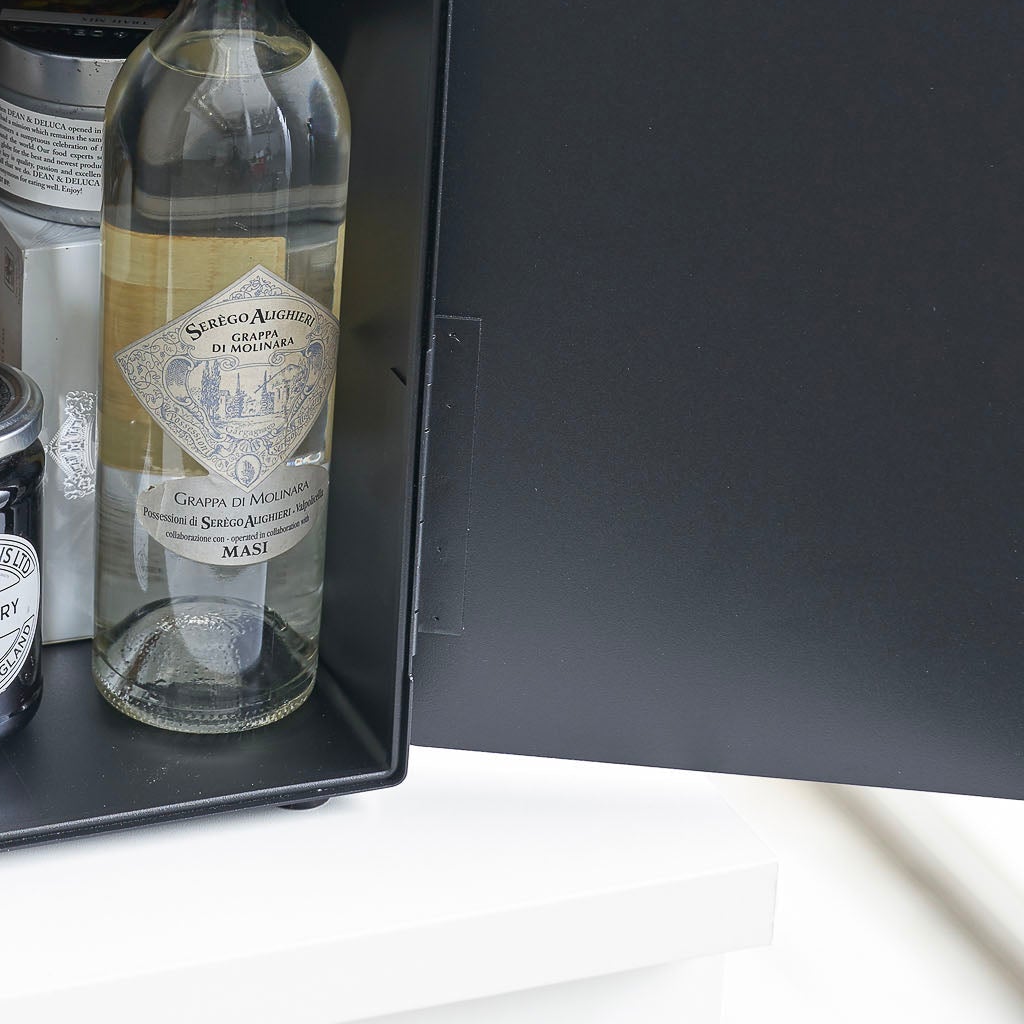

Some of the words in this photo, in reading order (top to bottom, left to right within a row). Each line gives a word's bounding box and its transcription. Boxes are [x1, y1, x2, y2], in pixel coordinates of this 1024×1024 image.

[7, 108, 25, 121] DEAN
[26, 116, 33, 124] &
[34, 118, 67, 131] DELUCA
[68, 125, 93, 134] opened
[31, 127, 49, 136] which
[50, 132, 75, 141] remains
[76, 134, 87, 142] the
[37, 145, 50, 154] Our
[52, 148, 67, 157] food
[70, 153, 94, 161] experts
[52, 141, 88, 151] celebration
[90, 144, 98, 152] of
[16, 157, 35, 169] quality,
[36, 164, 58, 174] passion
[74, 170, 102, 178] excellen
[30, 152, 43, 162] best
[56, 159, 78, 168] newest
[79, 162, 102, 170] produc
[32, 170, 54, 181] DEAN
[65, 176, 100, 186] DELUCA
[27, 179, 46, 190] eating
[46, 184, 61, 192] well.
[61, 185, 83, 196] Enjoy!
[249, 308, 316, 328] ALIGHIERI
[231, 329, 279, 342] GRAPPA
[212, 343, 227, 353] DI
[230, 336, 295, 353] MOLINARA
[174, 491, 227, 508] GRAPPA
[232, 496, 245, 508] DI
[250, 480, 309, 505] MOLINARA
[143, 506, 187, 526] Possessioni
[189, 515, 198, 526] di
[244, 507, 291, 529] ALIGHIERI
[165, 530, 211, 543] collaborazione
[230, 531, 258, 544] operated
[259, 531, 266, 540] in
[266, 520, 300, 538] collaboration
[221, 542, 268, 559] MASI
[12, 550, 32, 574] LTD
